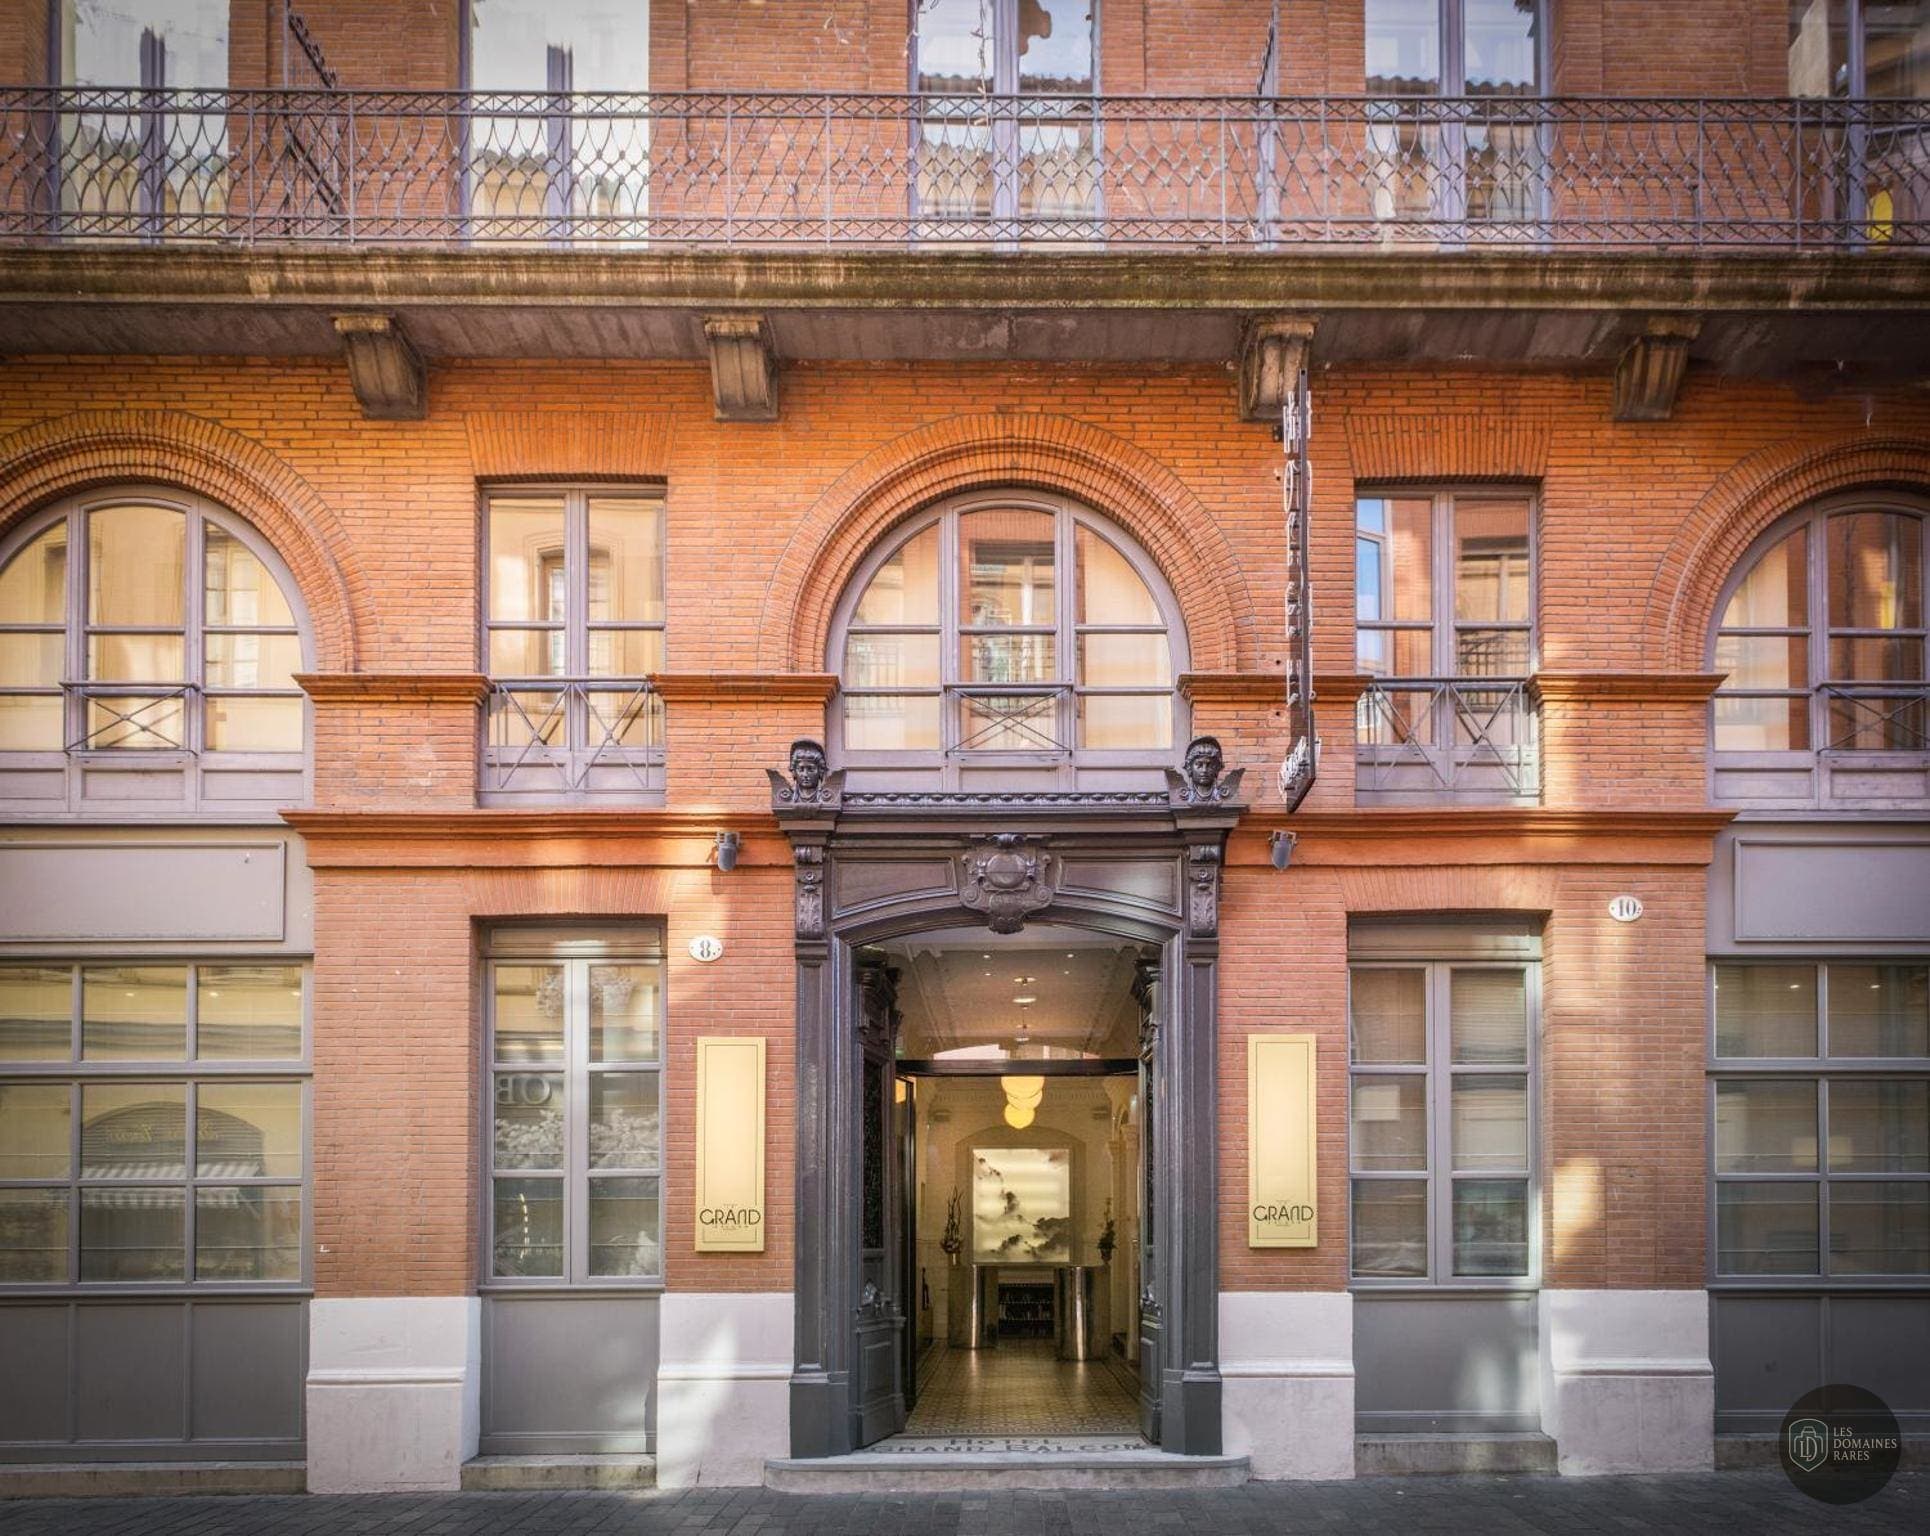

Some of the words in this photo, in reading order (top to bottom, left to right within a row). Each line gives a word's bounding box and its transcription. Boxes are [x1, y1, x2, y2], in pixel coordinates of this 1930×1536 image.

[1619, 899, 1637, 917] 10
[700, 939, 711, 958] 8
[700, 1208, 761, 1225] GRAND
[1253, 1205, 1314, 1221] GRAND
